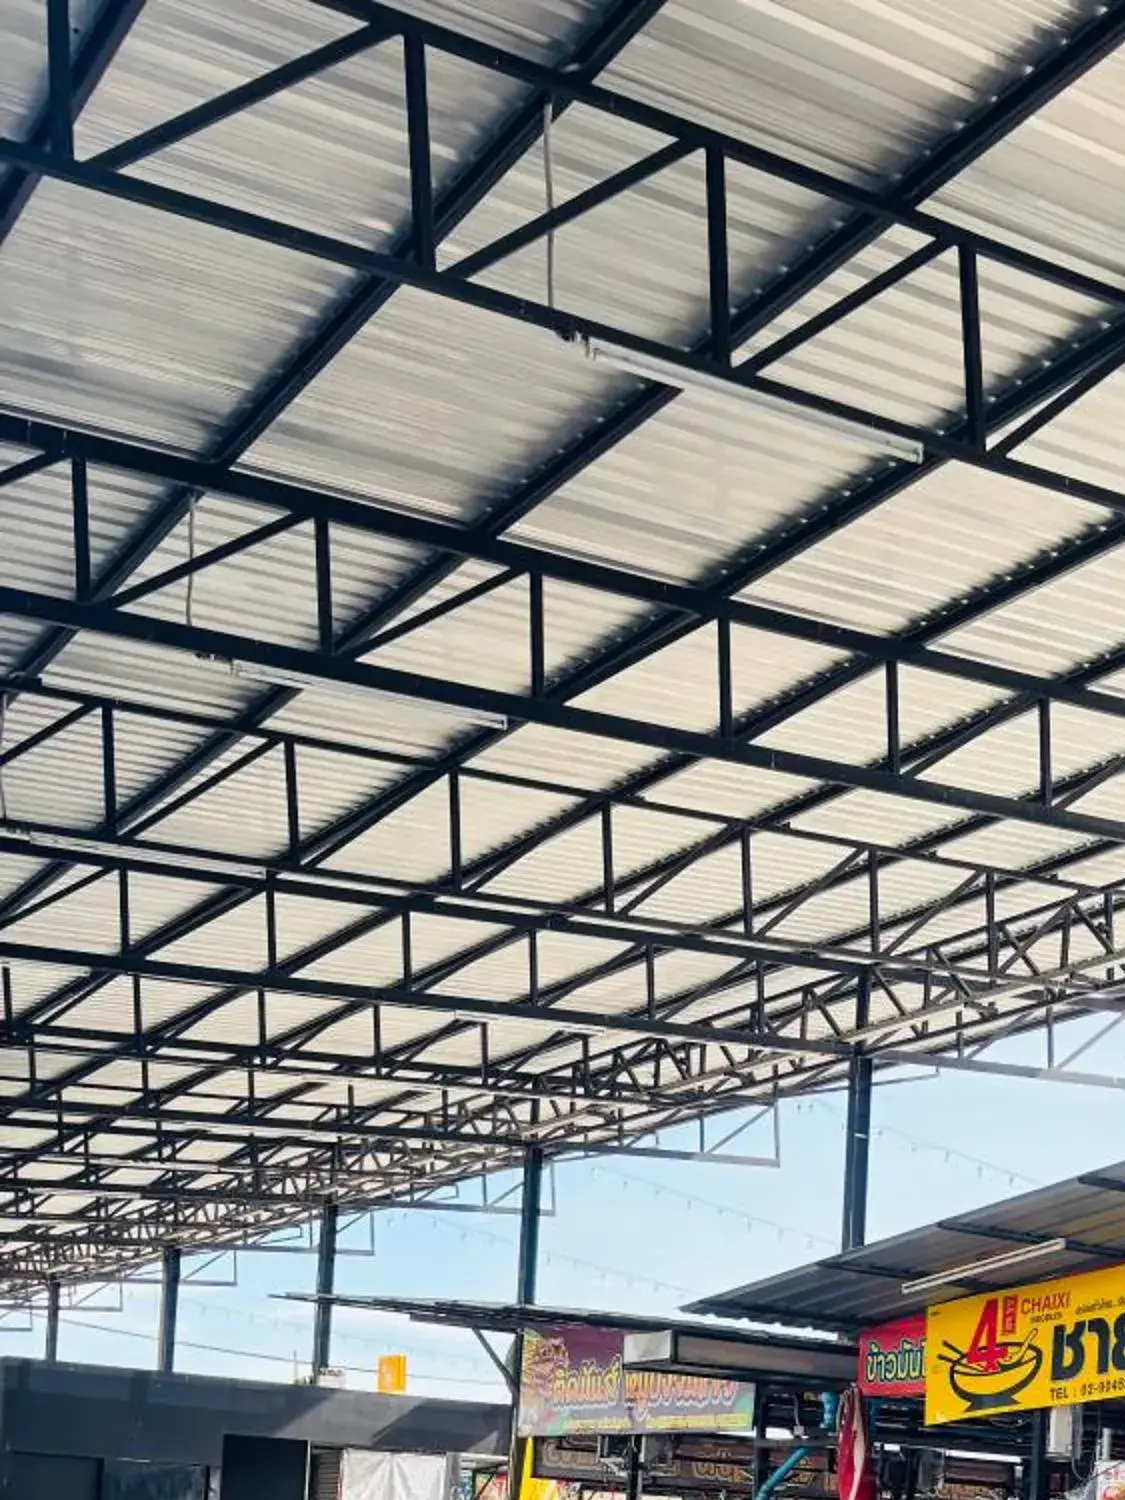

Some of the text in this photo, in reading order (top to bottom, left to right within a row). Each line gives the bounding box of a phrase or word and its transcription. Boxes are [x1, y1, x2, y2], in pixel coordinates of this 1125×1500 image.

[1021, 1290, 1071, 1315] CHAIXI
[866, 1340, 927, 1382] ข้าวมัน
